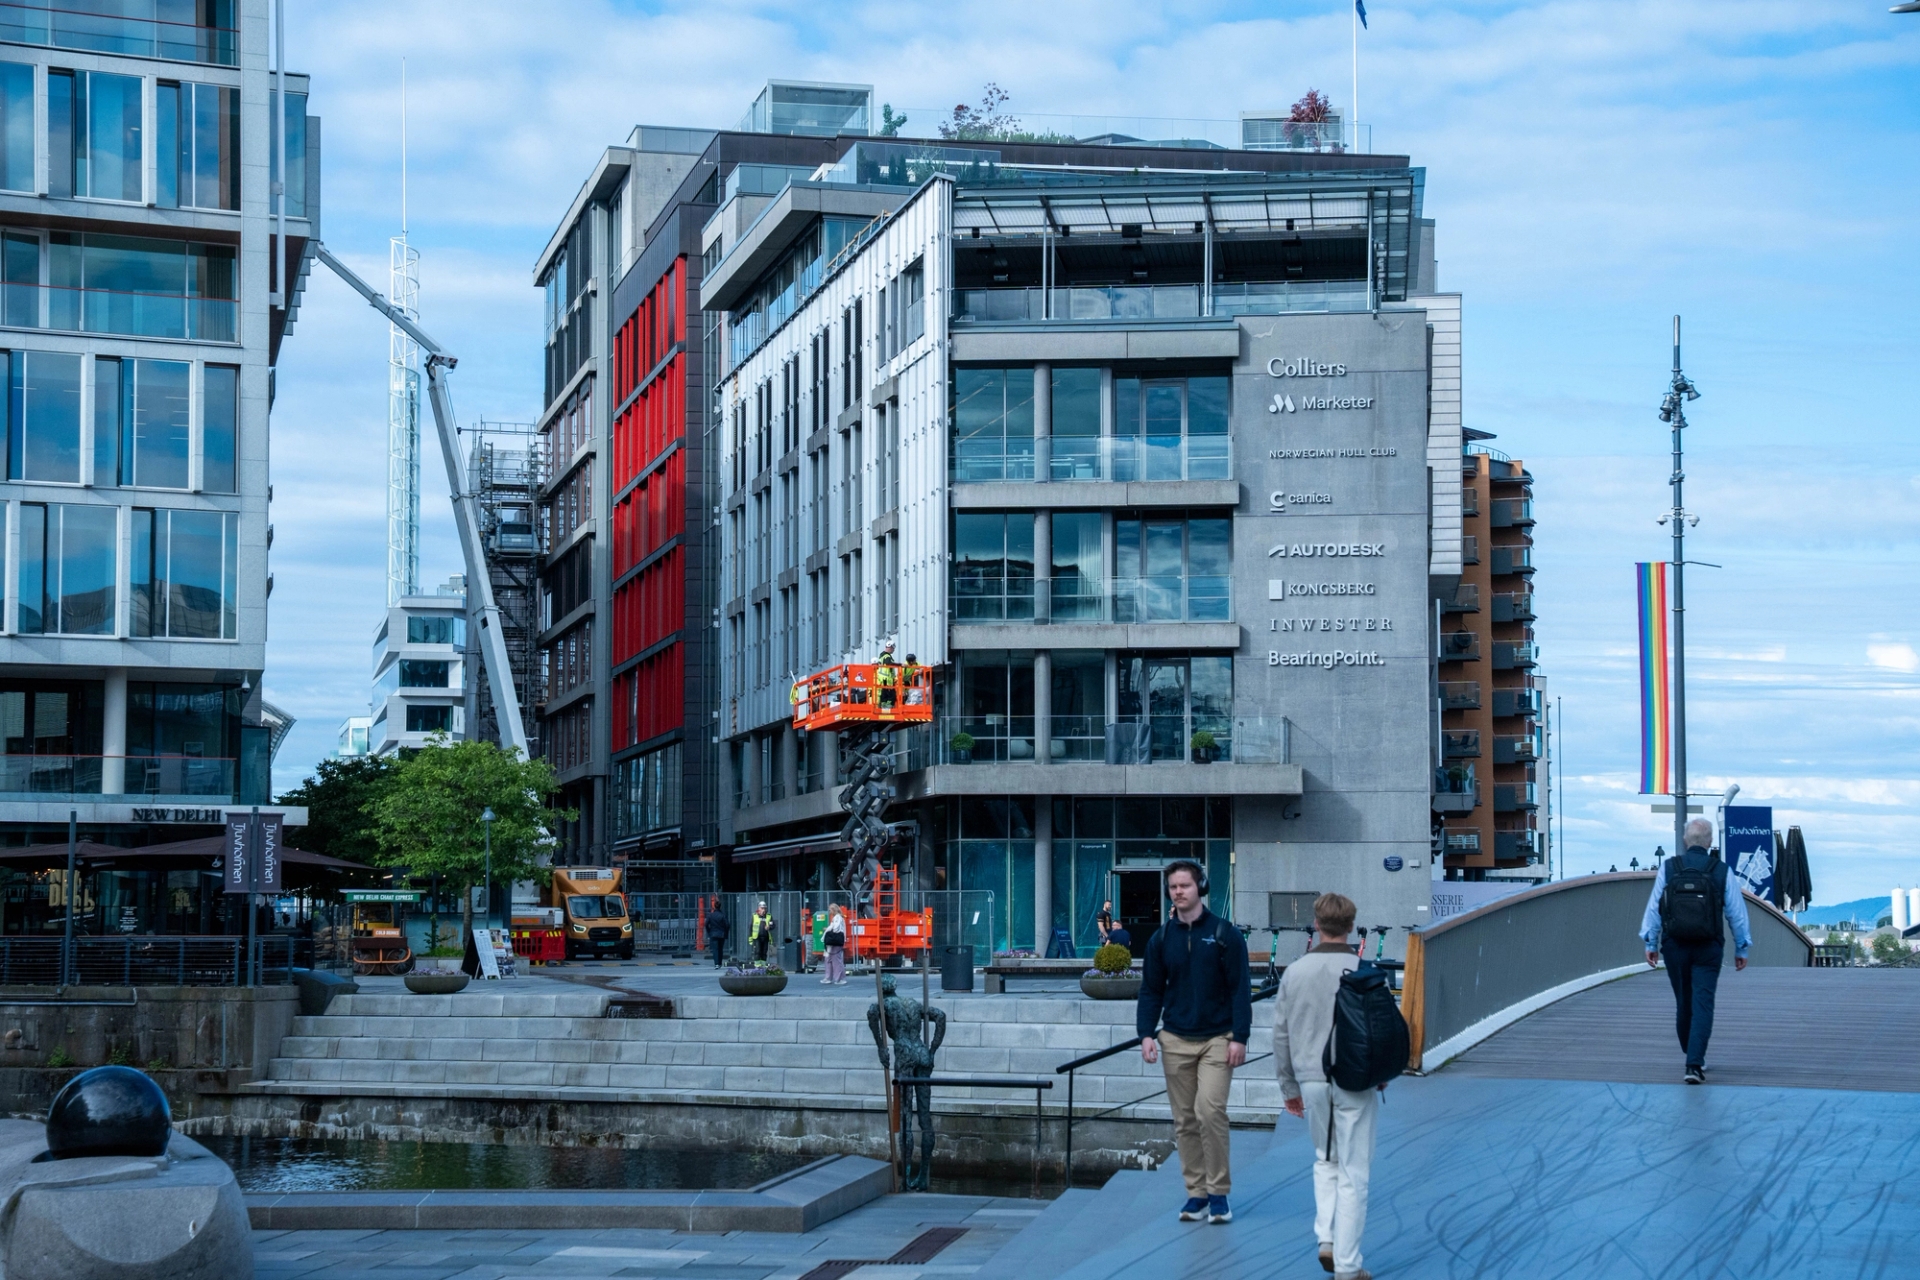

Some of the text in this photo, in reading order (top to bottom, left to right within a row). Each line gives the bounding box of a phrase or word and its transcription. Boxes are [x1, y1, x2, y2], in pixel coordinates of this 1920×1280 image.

[1266, 357, 1347, 378] Colliers
[1302, 395, 1374, 410] Marketer
[1269, 447, 1397, 459] NORWEGIAN HULL CLUB
[1288, 491, 1332, 503] canica
[1290, 543, 1385, 557] AUTODESK
[1288, 582, 1375, 596] KONGSBERG
[1269, 618, 1393, 631] INWESTER
[1268, 650, 1386, 669] BearingPoint.
[131, 808, 222, 823] NEW DELHI
[1728, 826, 1771, 837] Tjuvholmen
[231, 822, 246, 884] Tjuvholmen
[262, 822, 277, 884] Tjuvholmen
